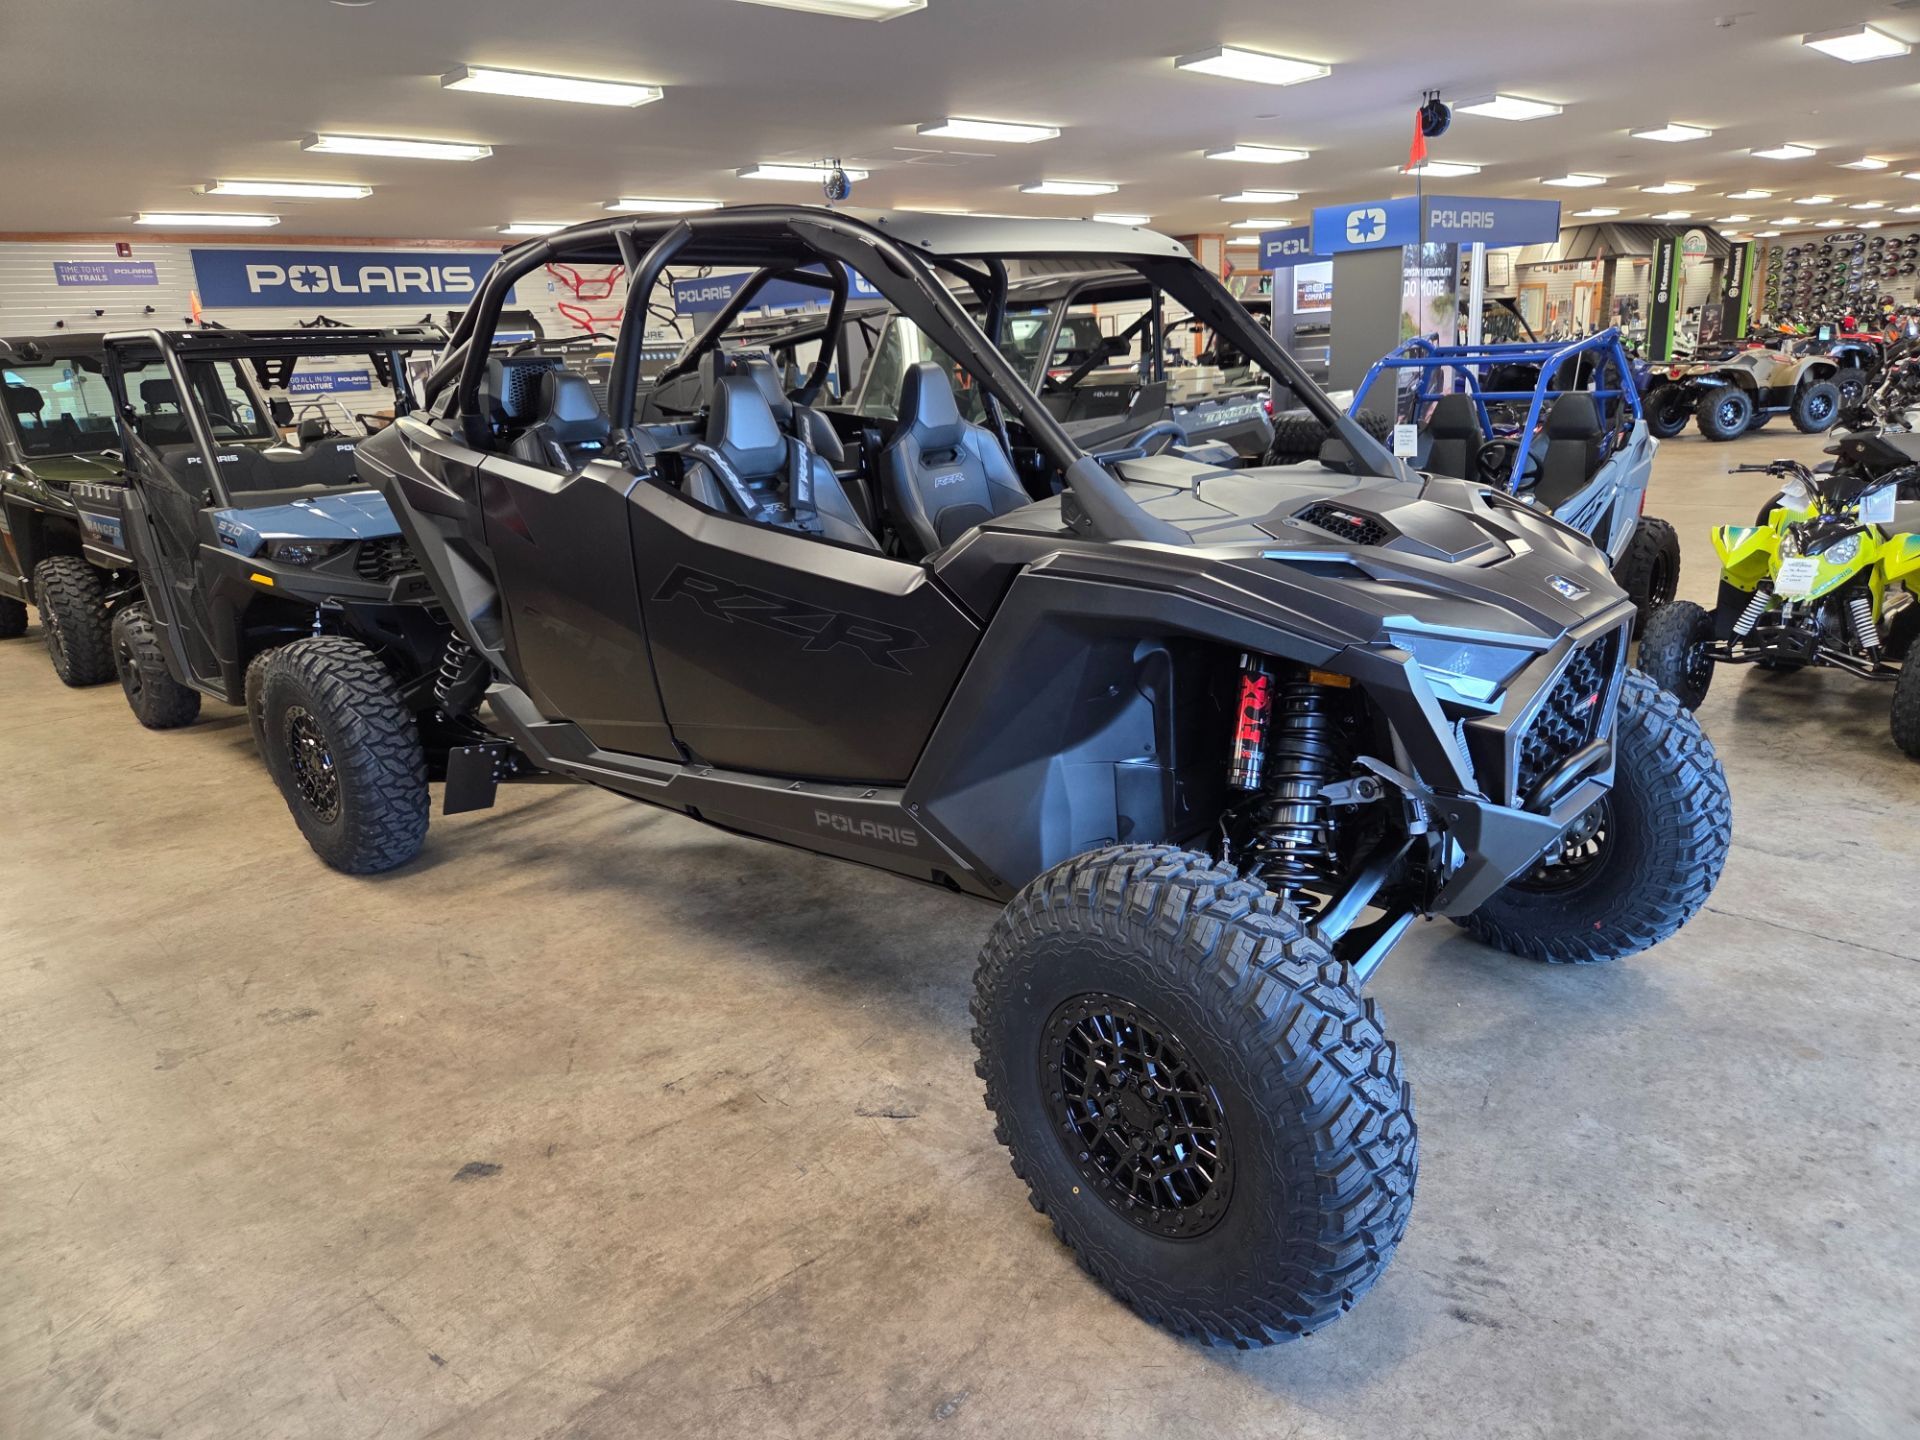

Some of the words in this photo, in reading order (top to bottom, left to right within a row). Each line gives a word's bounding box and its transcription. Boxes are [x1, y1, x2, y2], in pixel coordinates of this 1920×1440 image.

[1430, 210, 1495, 229] POLARIS
[62, 274, 79, 282] THE
[80, 274, 108, 282] TRAILS
[246, 264, 475, 293] POLARIS
[678, 285, 732, 304] POLARIS
[1404, 280, 1417, 297] DO
[1421, 279, 1445, 297] MORE
[292, 382, 334, 391] ADVENTURE
[337, 375, 369, 383] POLARIS
[651, 563, 930, 676] RZR
[814, 809, 919, 848] POLARIS
